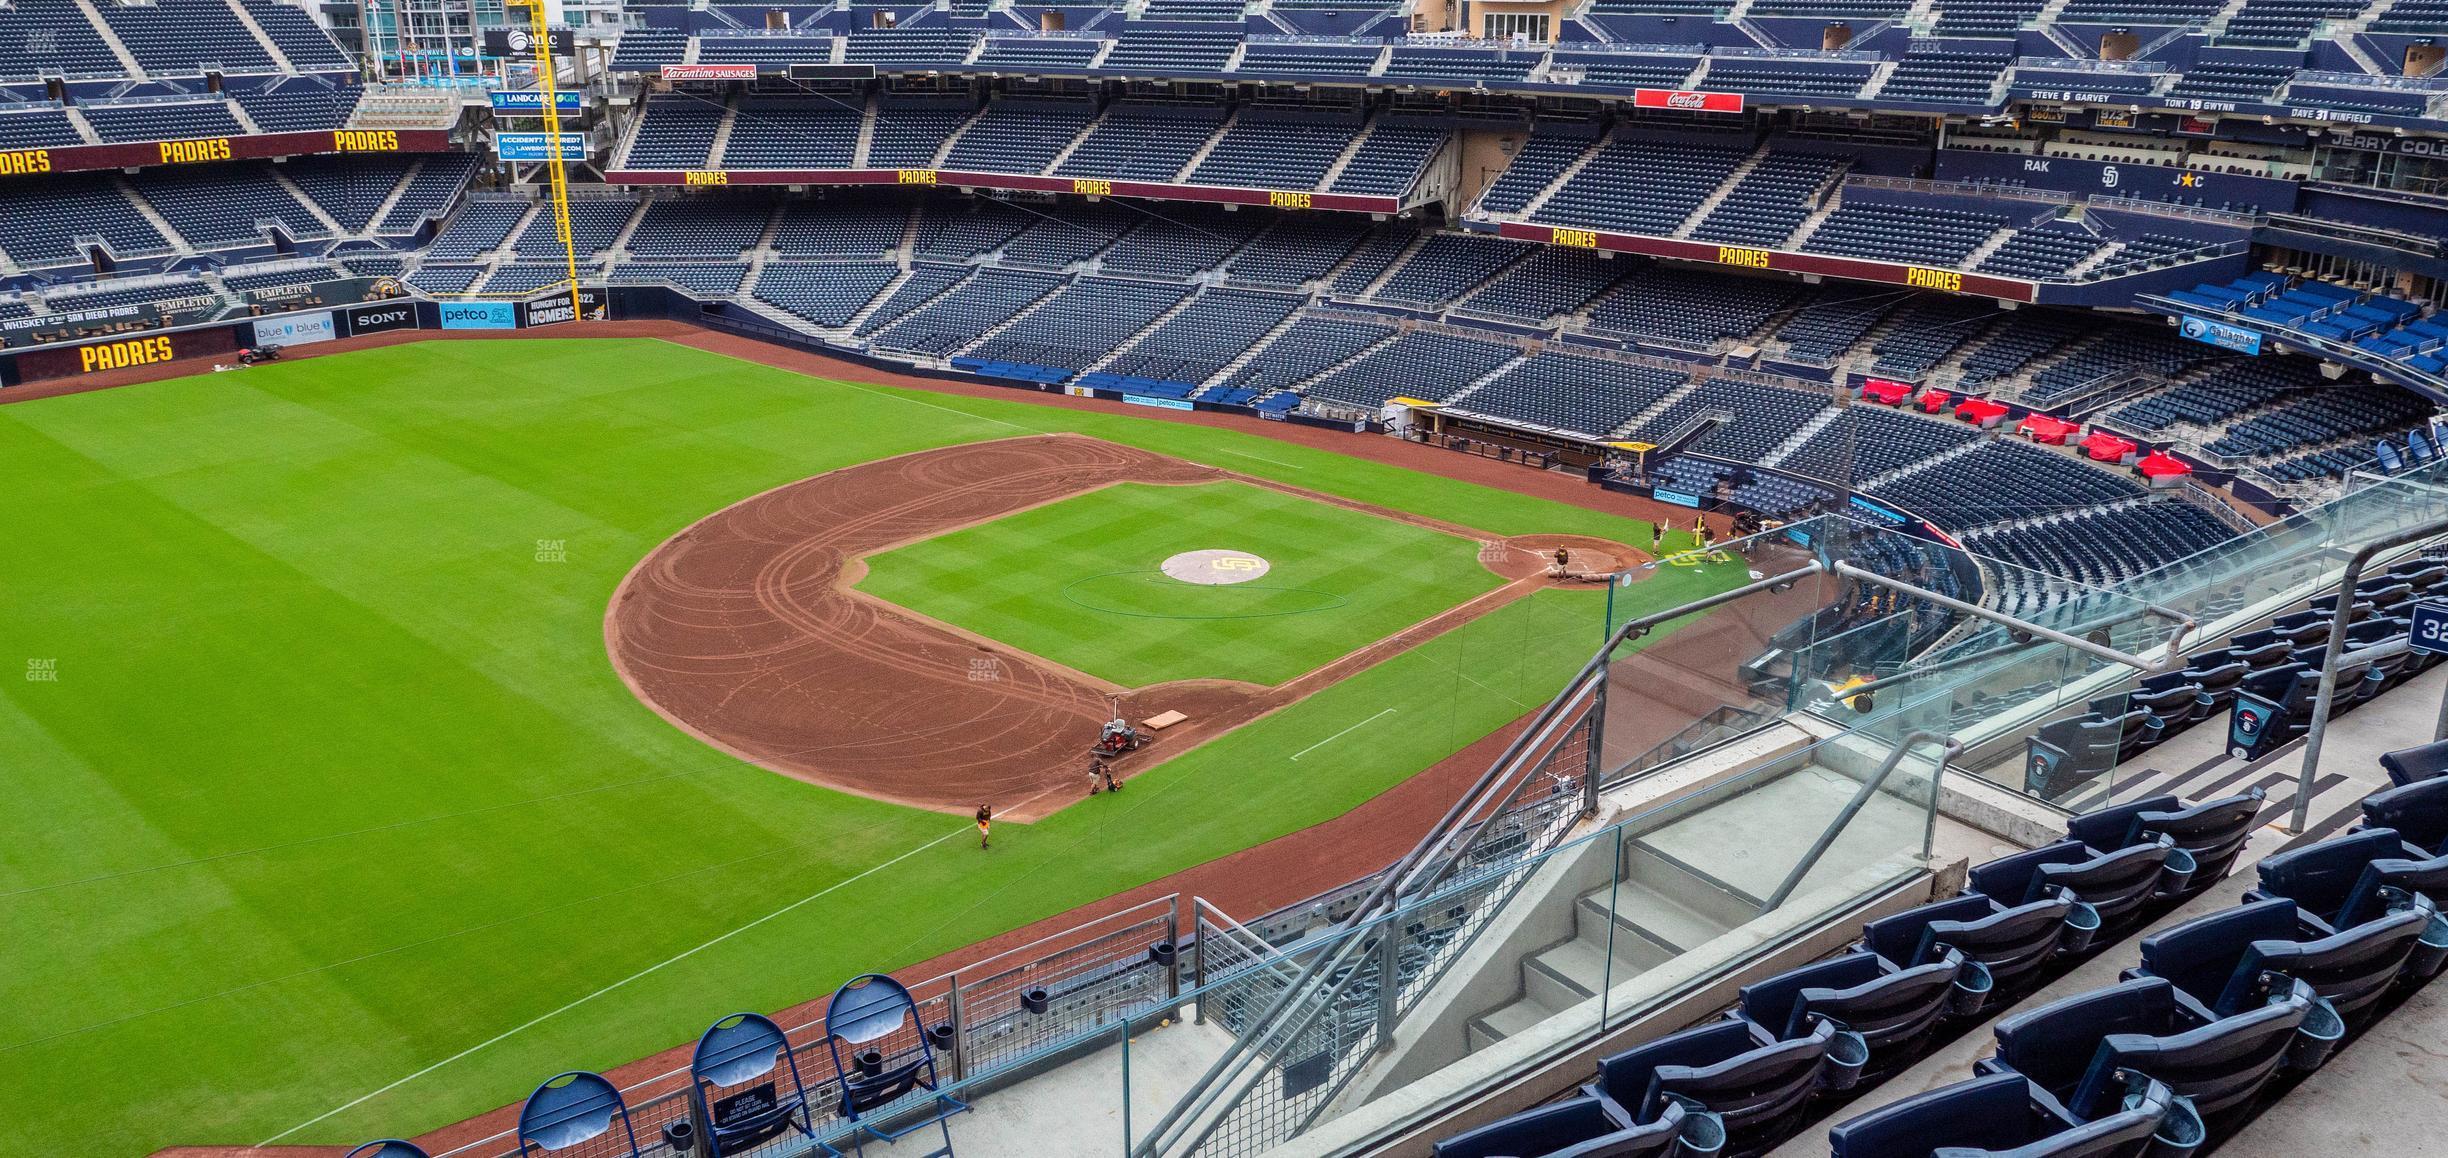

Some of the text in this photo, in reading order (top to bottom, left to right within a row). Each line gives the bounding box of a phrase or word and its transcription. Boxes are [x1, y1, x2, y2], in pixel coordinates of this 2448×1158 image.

[664, 66, 755, 78] Tarantino SAUSAGES
[2031, 90, 2110, 103] STEVE 6 GARVEY
[2164, 99, 2235, 112] TONY 19 GWYNN
[2291, 108, 2372, 124] DAVE 31 WINFIELD
[334, 130, 398, 152] PADRES
[2331, 133, 2393, 150] JERRY
[159, 138, 231, 164] PADRES
[2024, 159, 2050, 172] RAK
[685, 171, 728, 184] PADRES
[898, 170, 937, 184] PADRES
[1074, 179, 1111, 195] PADRES
[1270, 191, 1311, 208] PADRES
[1552, 228, 1596, 248] PADRES
[1718, 247, 1769, 268] PADRES
[1906, 266, 1961, 291] PADRES
[253, 284, 312, 300] TEMPLETON
[578, 293, 594, 304] 322
[153, 295, 217, 312] TEMPLETON
[531, 297, 570, 310] HUNGRY FOR
[3, 317, 46, 331] WHISKEY
[67, 313, 83, 322] SAN
[85, 311, 108, 320] DIEGO
[109, 307, 139, 317] PADRES
[358, 311, 408, 326] SONY
[445, 309, 488, 323] petco
[529, 306, 575, 325] HOMERS
[258, 326, 282, 338] blue
[296, 321, 320, 333] blue
[2209, 325, 2257, 346] Gallagher
[80, 336, 173, 373] PADRES
[1124, 395, 1140, 403] petco
[1158, 399, 1176, 407] petco
[1655, 491, 1676, 500] petco
[734, 1094, 756, 1107] PLEASE
